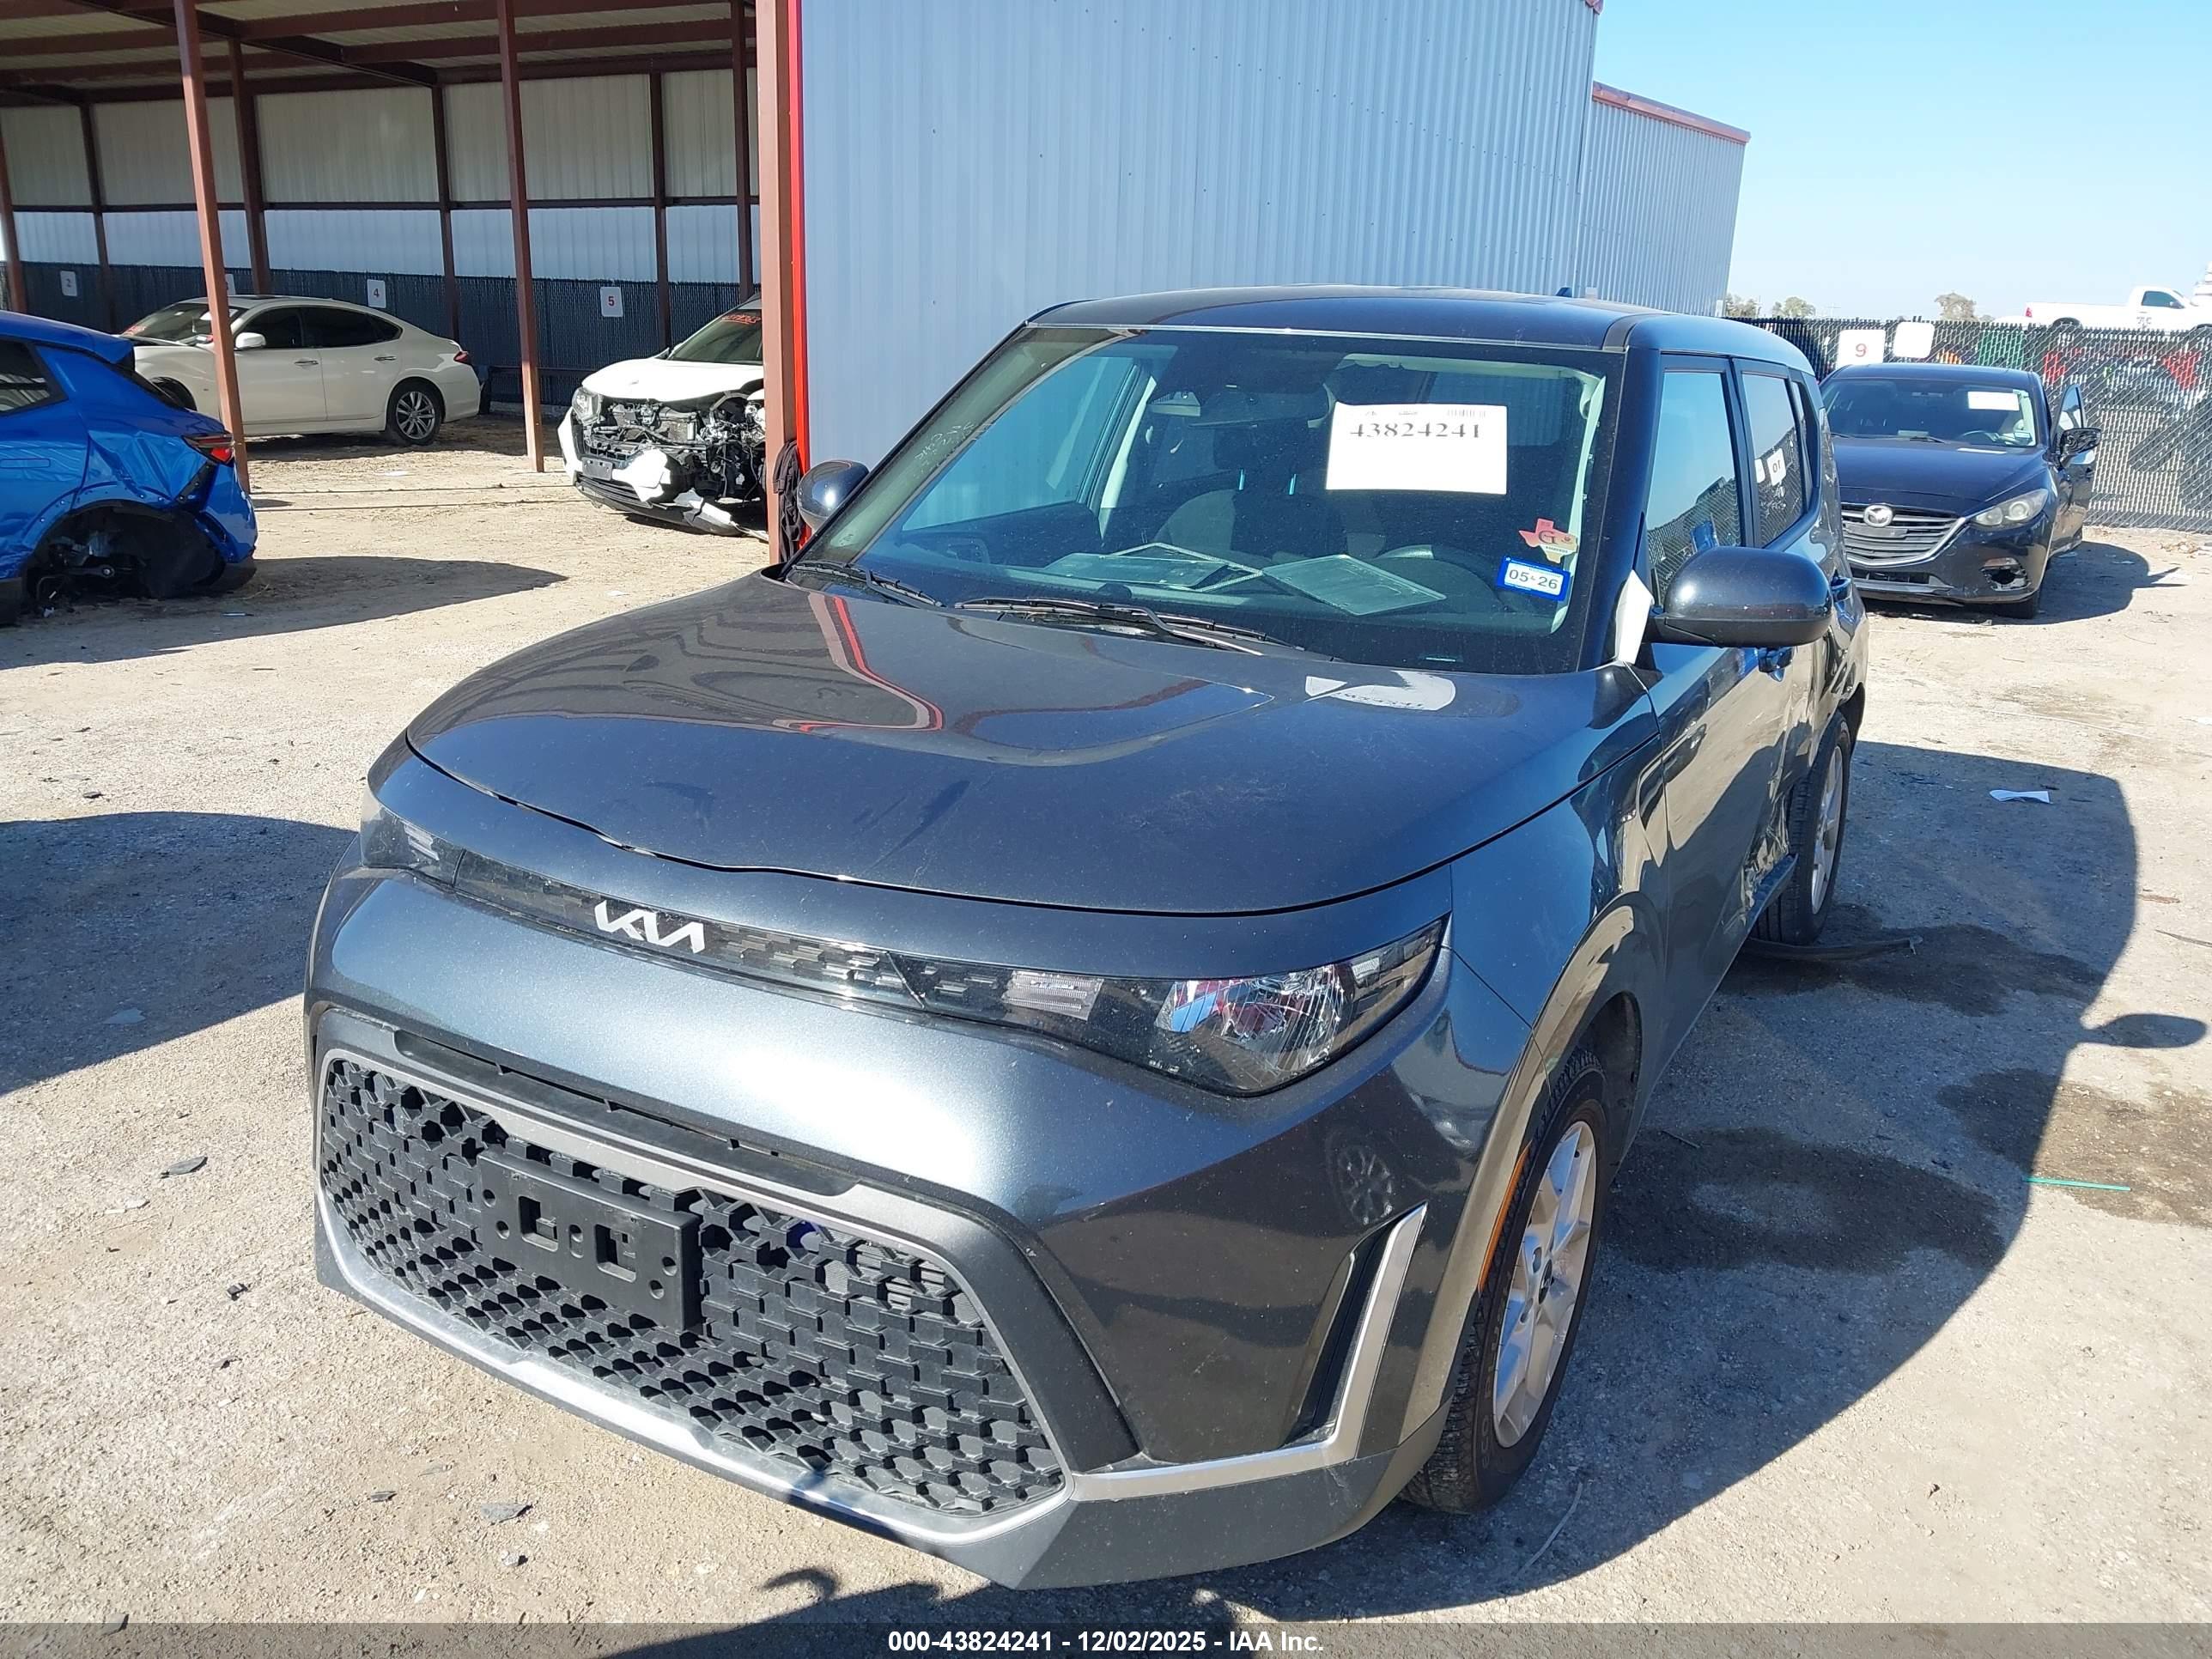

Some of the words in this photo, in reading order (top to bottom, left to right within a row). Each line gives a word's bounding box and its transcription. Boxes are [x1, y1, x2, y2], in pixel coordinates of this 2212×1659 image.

[373, 288, 380, 298] 4
[608, 295, 615, 307] 5
[1855, 343, 1868, 357] 9
[1349, 422, 1480, 438] 43824241
[594, 899, 705, 954] KIA
